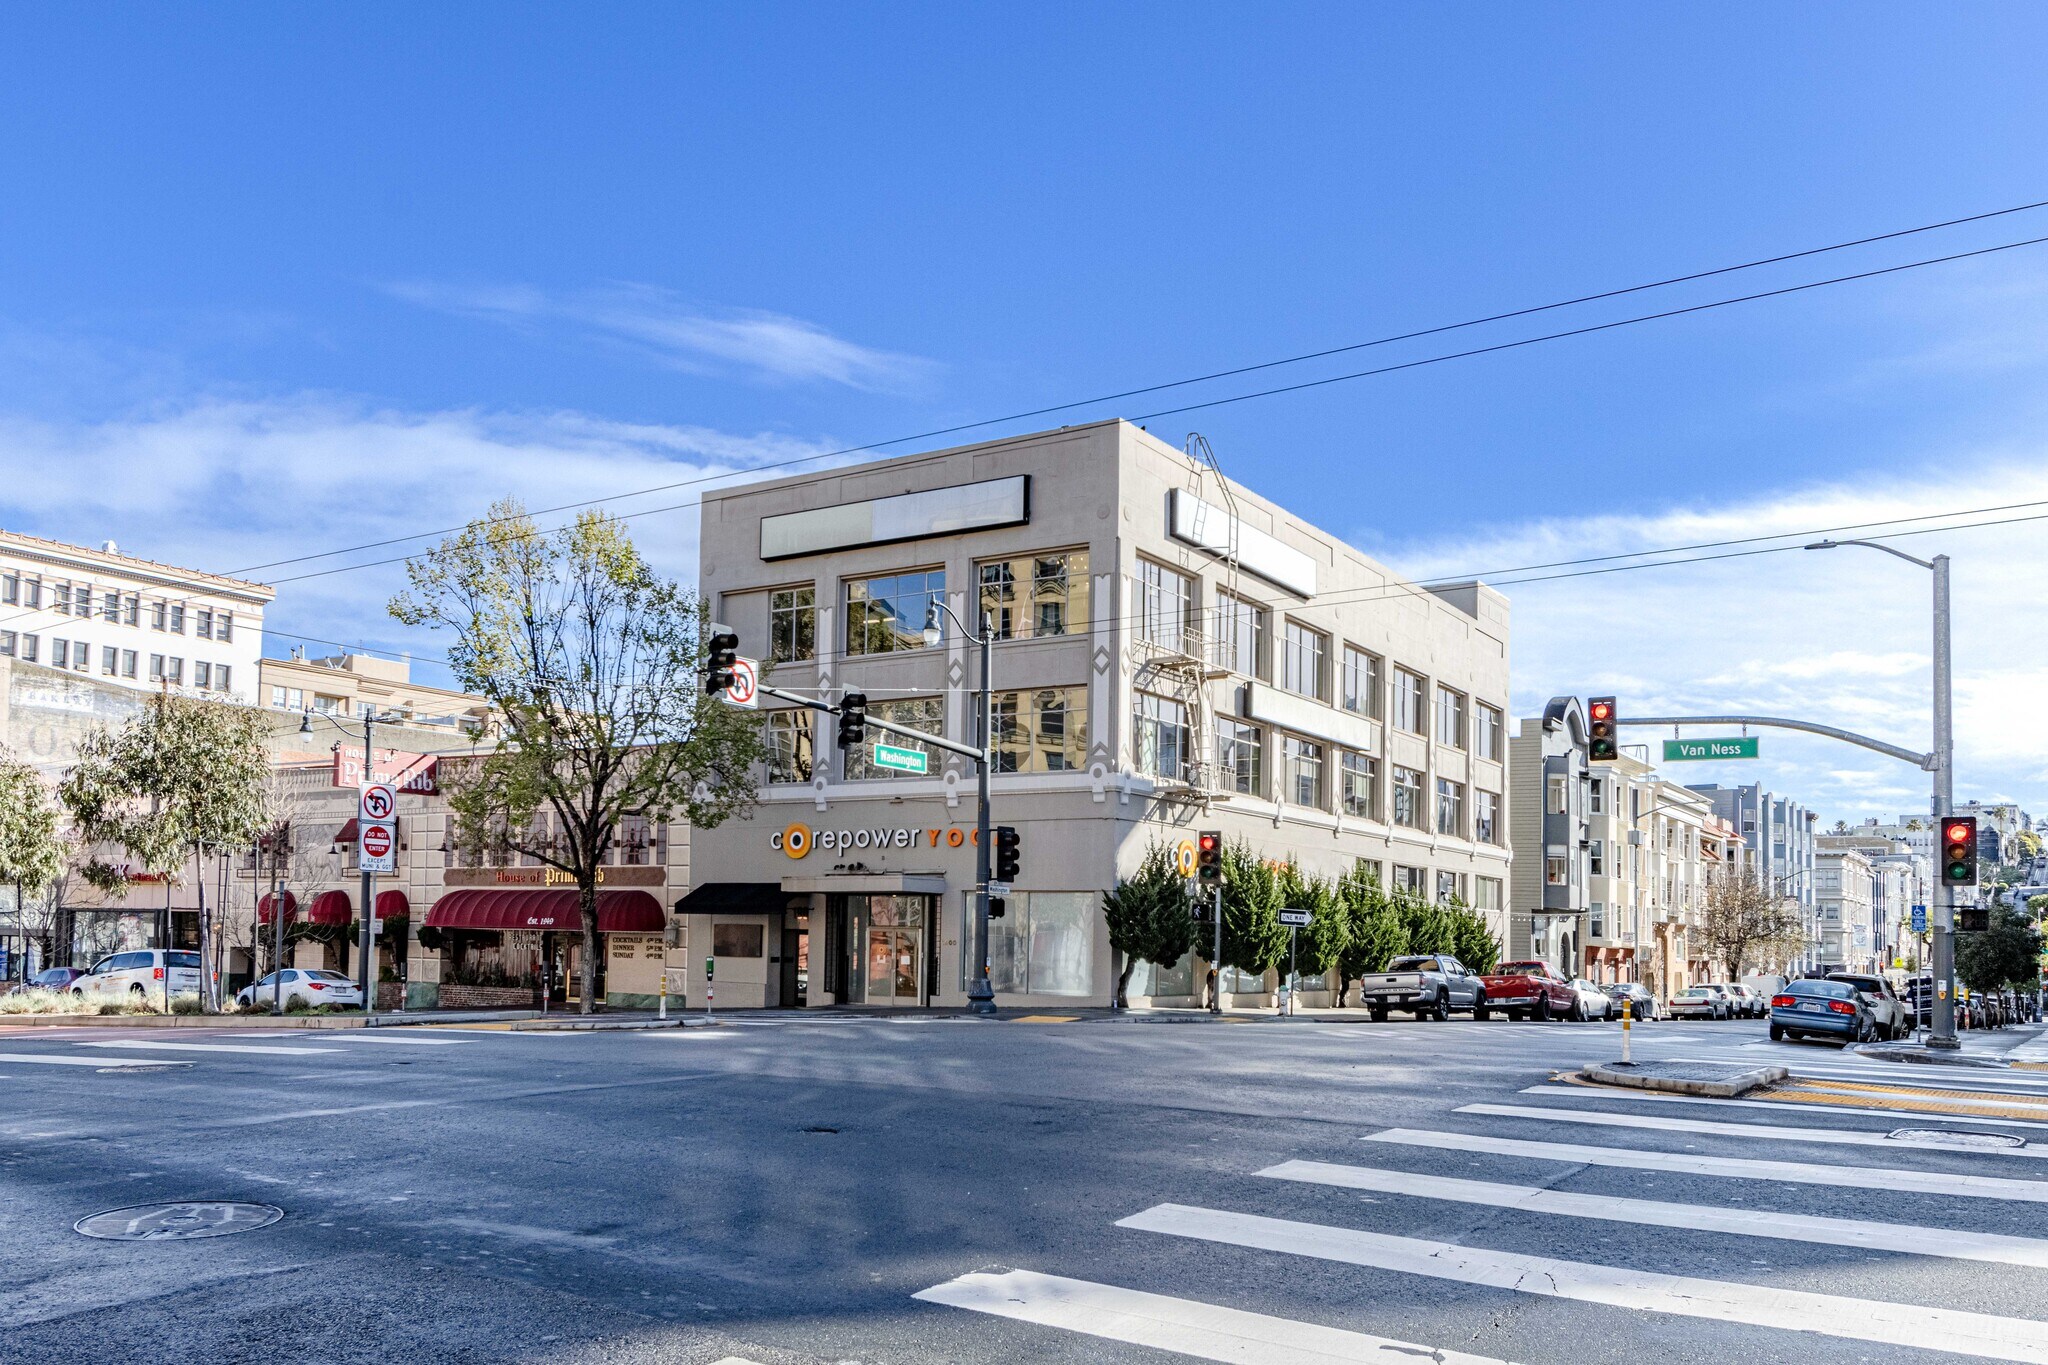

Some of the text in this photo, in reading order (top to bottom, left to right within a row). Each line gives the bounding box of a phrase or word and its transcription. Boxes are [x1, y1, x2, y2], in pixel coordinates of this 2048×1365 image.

[344, 749, 380, 761] HOUE
[1680, 743, 1742, 756] Van Ness
[880, 749, 922, 769] Washington
[402, 768, 433, 791] Rib
[770, 825, 921, 857] corepower
[496, 871, 525, 883] House
[530, 871, 540, 883] of
[527, 917, 554, 925] Est. 1949
[612, 951, 634, 959] SUNDAY
